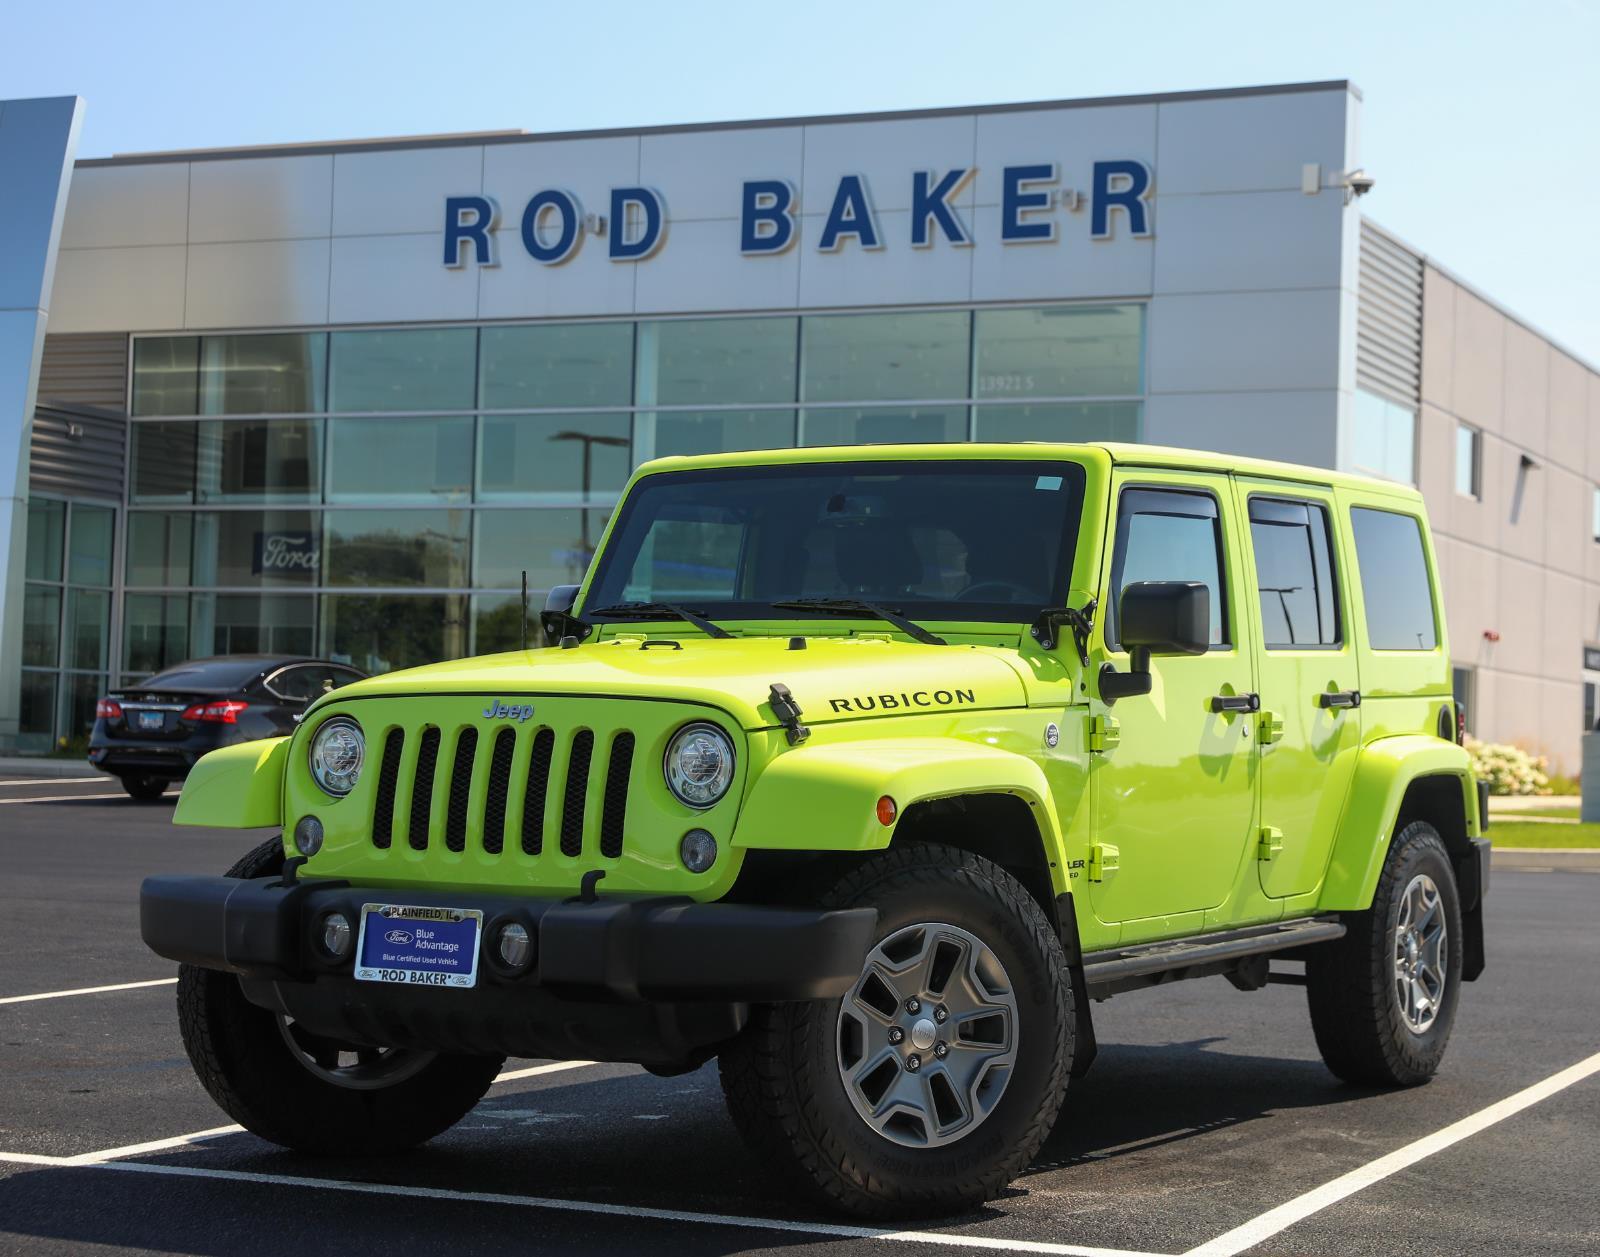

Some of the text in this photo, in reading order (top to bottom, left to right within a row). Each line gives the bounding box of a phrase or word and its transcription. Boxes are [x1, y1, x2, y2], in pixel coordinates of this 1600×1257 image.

[443, 160, 1154, 270] ROD BAKER
[263, 536, 320, 568] Ford
[828, 689, 976, 713] RUBICON
[482, 699, 535, 723] Jeep
[416, 928, 435, 939] Blue
[415, 939, 460, 953] Advantage
[382, 953, 459, 966] Blue Certified Used Vehicle
[381, 970, 448, 985] ROD BAKER
